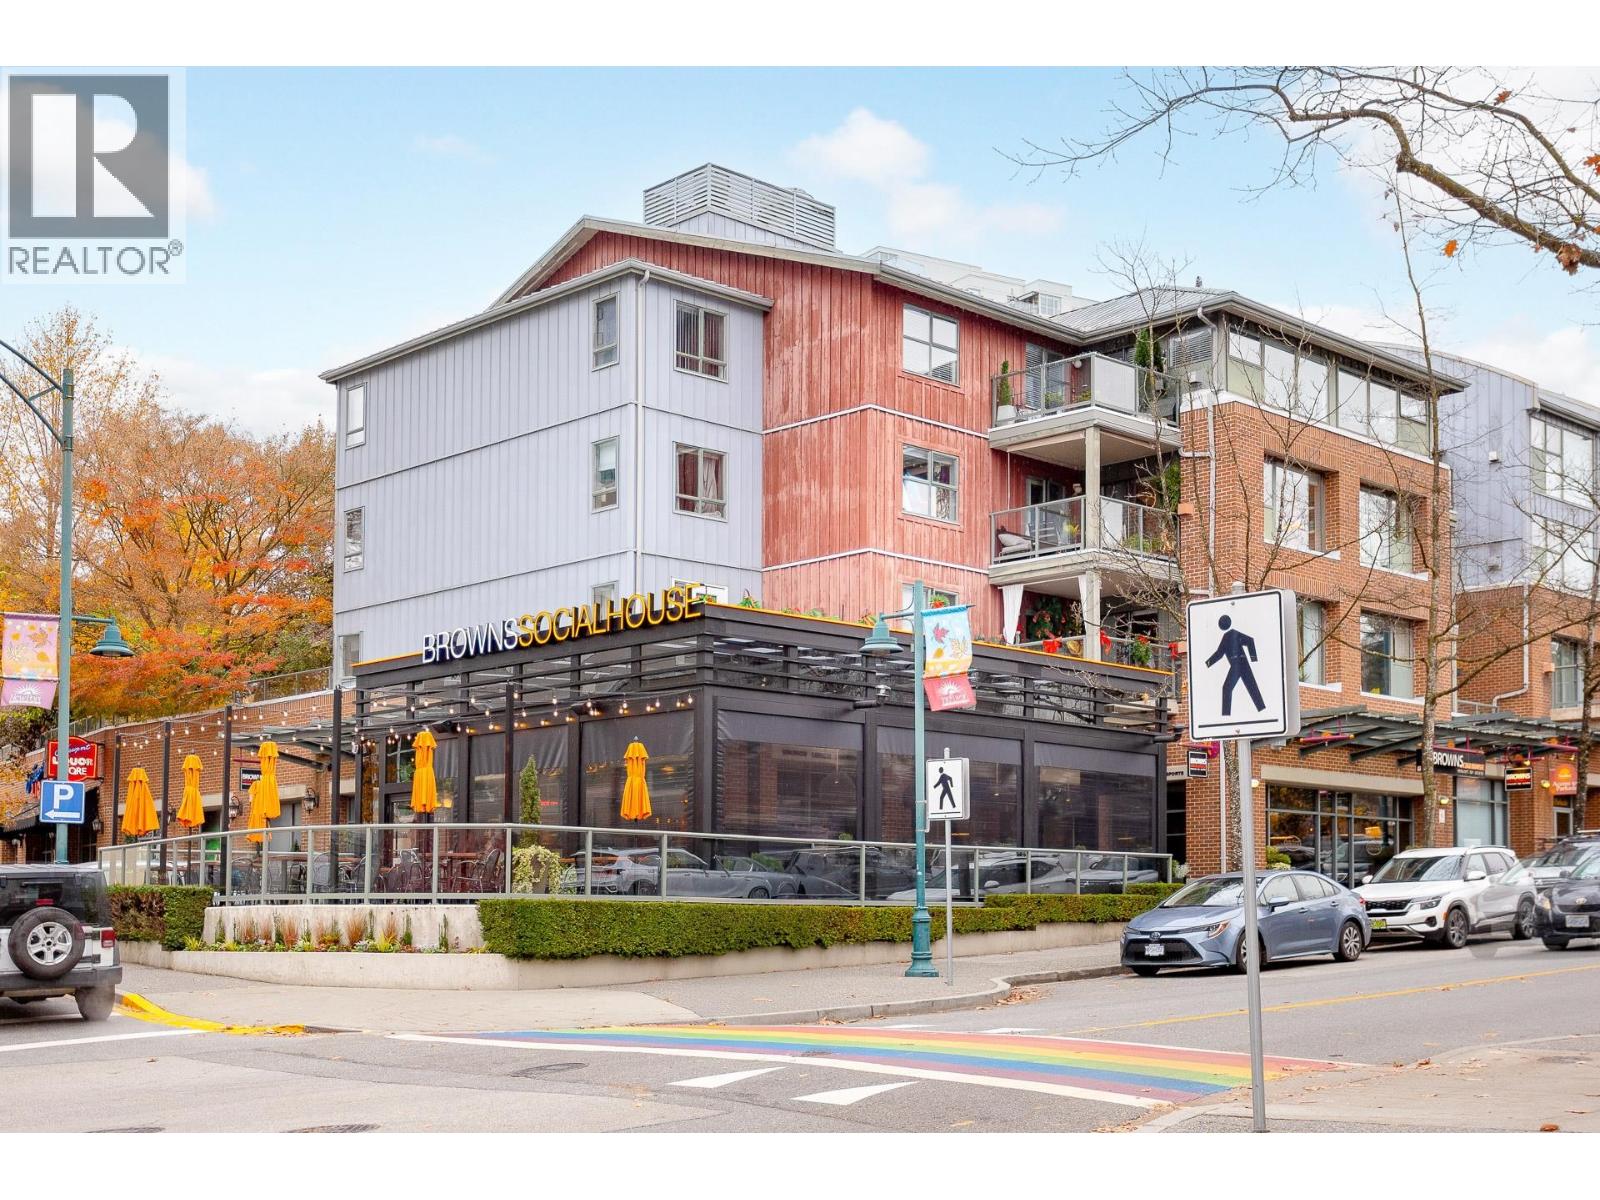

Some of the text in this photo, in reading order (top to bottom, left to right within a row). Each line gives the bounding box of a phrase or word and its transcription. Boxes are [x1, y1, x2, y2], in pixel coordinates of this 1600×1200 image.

[52, 755, 94, 766] LUOR
[1433, 751, 1464, 768] BROWNS
[68, 766, 88, 776] ORE
[53, 784, 74, 809] P
